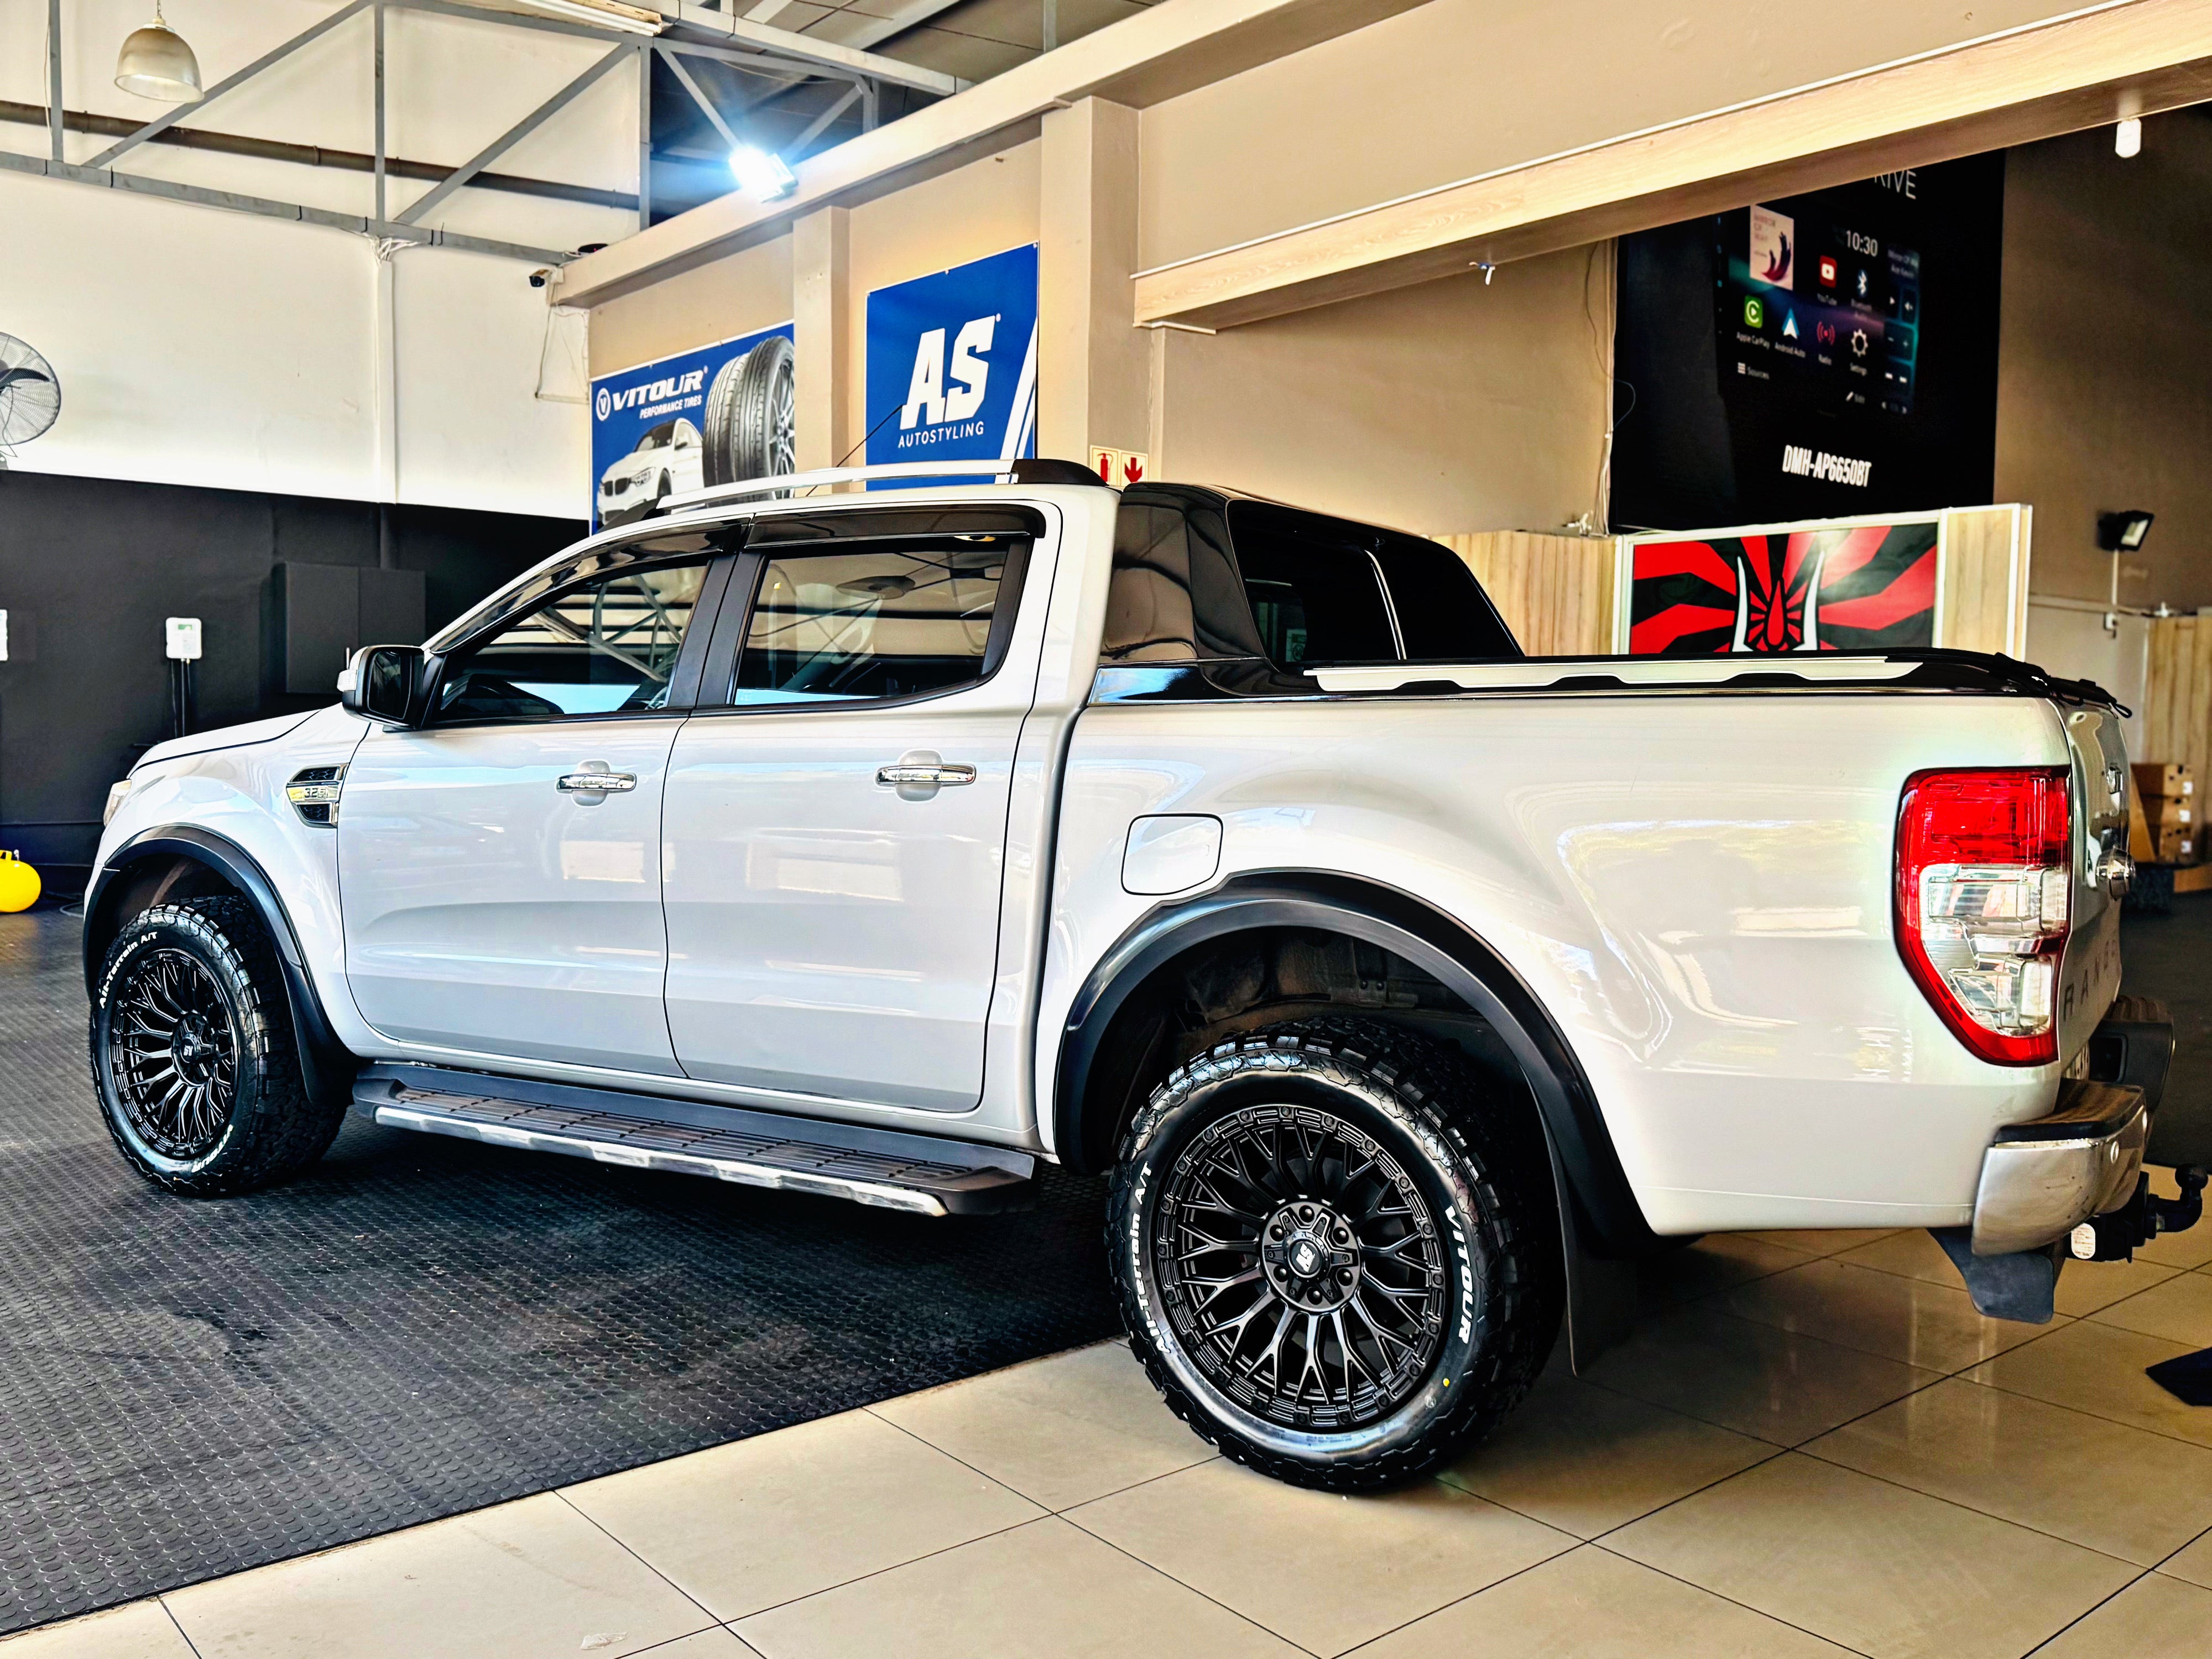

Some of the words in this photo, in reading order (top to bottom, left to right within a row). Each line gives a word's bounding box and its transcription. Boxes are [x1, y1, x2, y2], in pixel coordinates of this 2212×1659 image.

[1846, 229, 1878, 257] 10:30
[612, 370, 703, 411] VITOUR
[899, 315, 995, 430] AS
[639, 399, 683, 419] PERFORMANCE
[684, 394, 702, 409] TIRES
[898, 421, 984, 449] AUTOSTYLING
[1782, 445, 1872, 487] DMH-AP6650BT
[100, 941, 138, 1009] All-Terrain
[140, 931, 158, 944] A/T
[191, 1124, 233, 1173] VITOUR
[1134, 1161, 1152, 1205] A/T
[1129, 1212, 1171, 1354] All-Terrain
[1445, 1205, 1474, 1344] VITOUR
